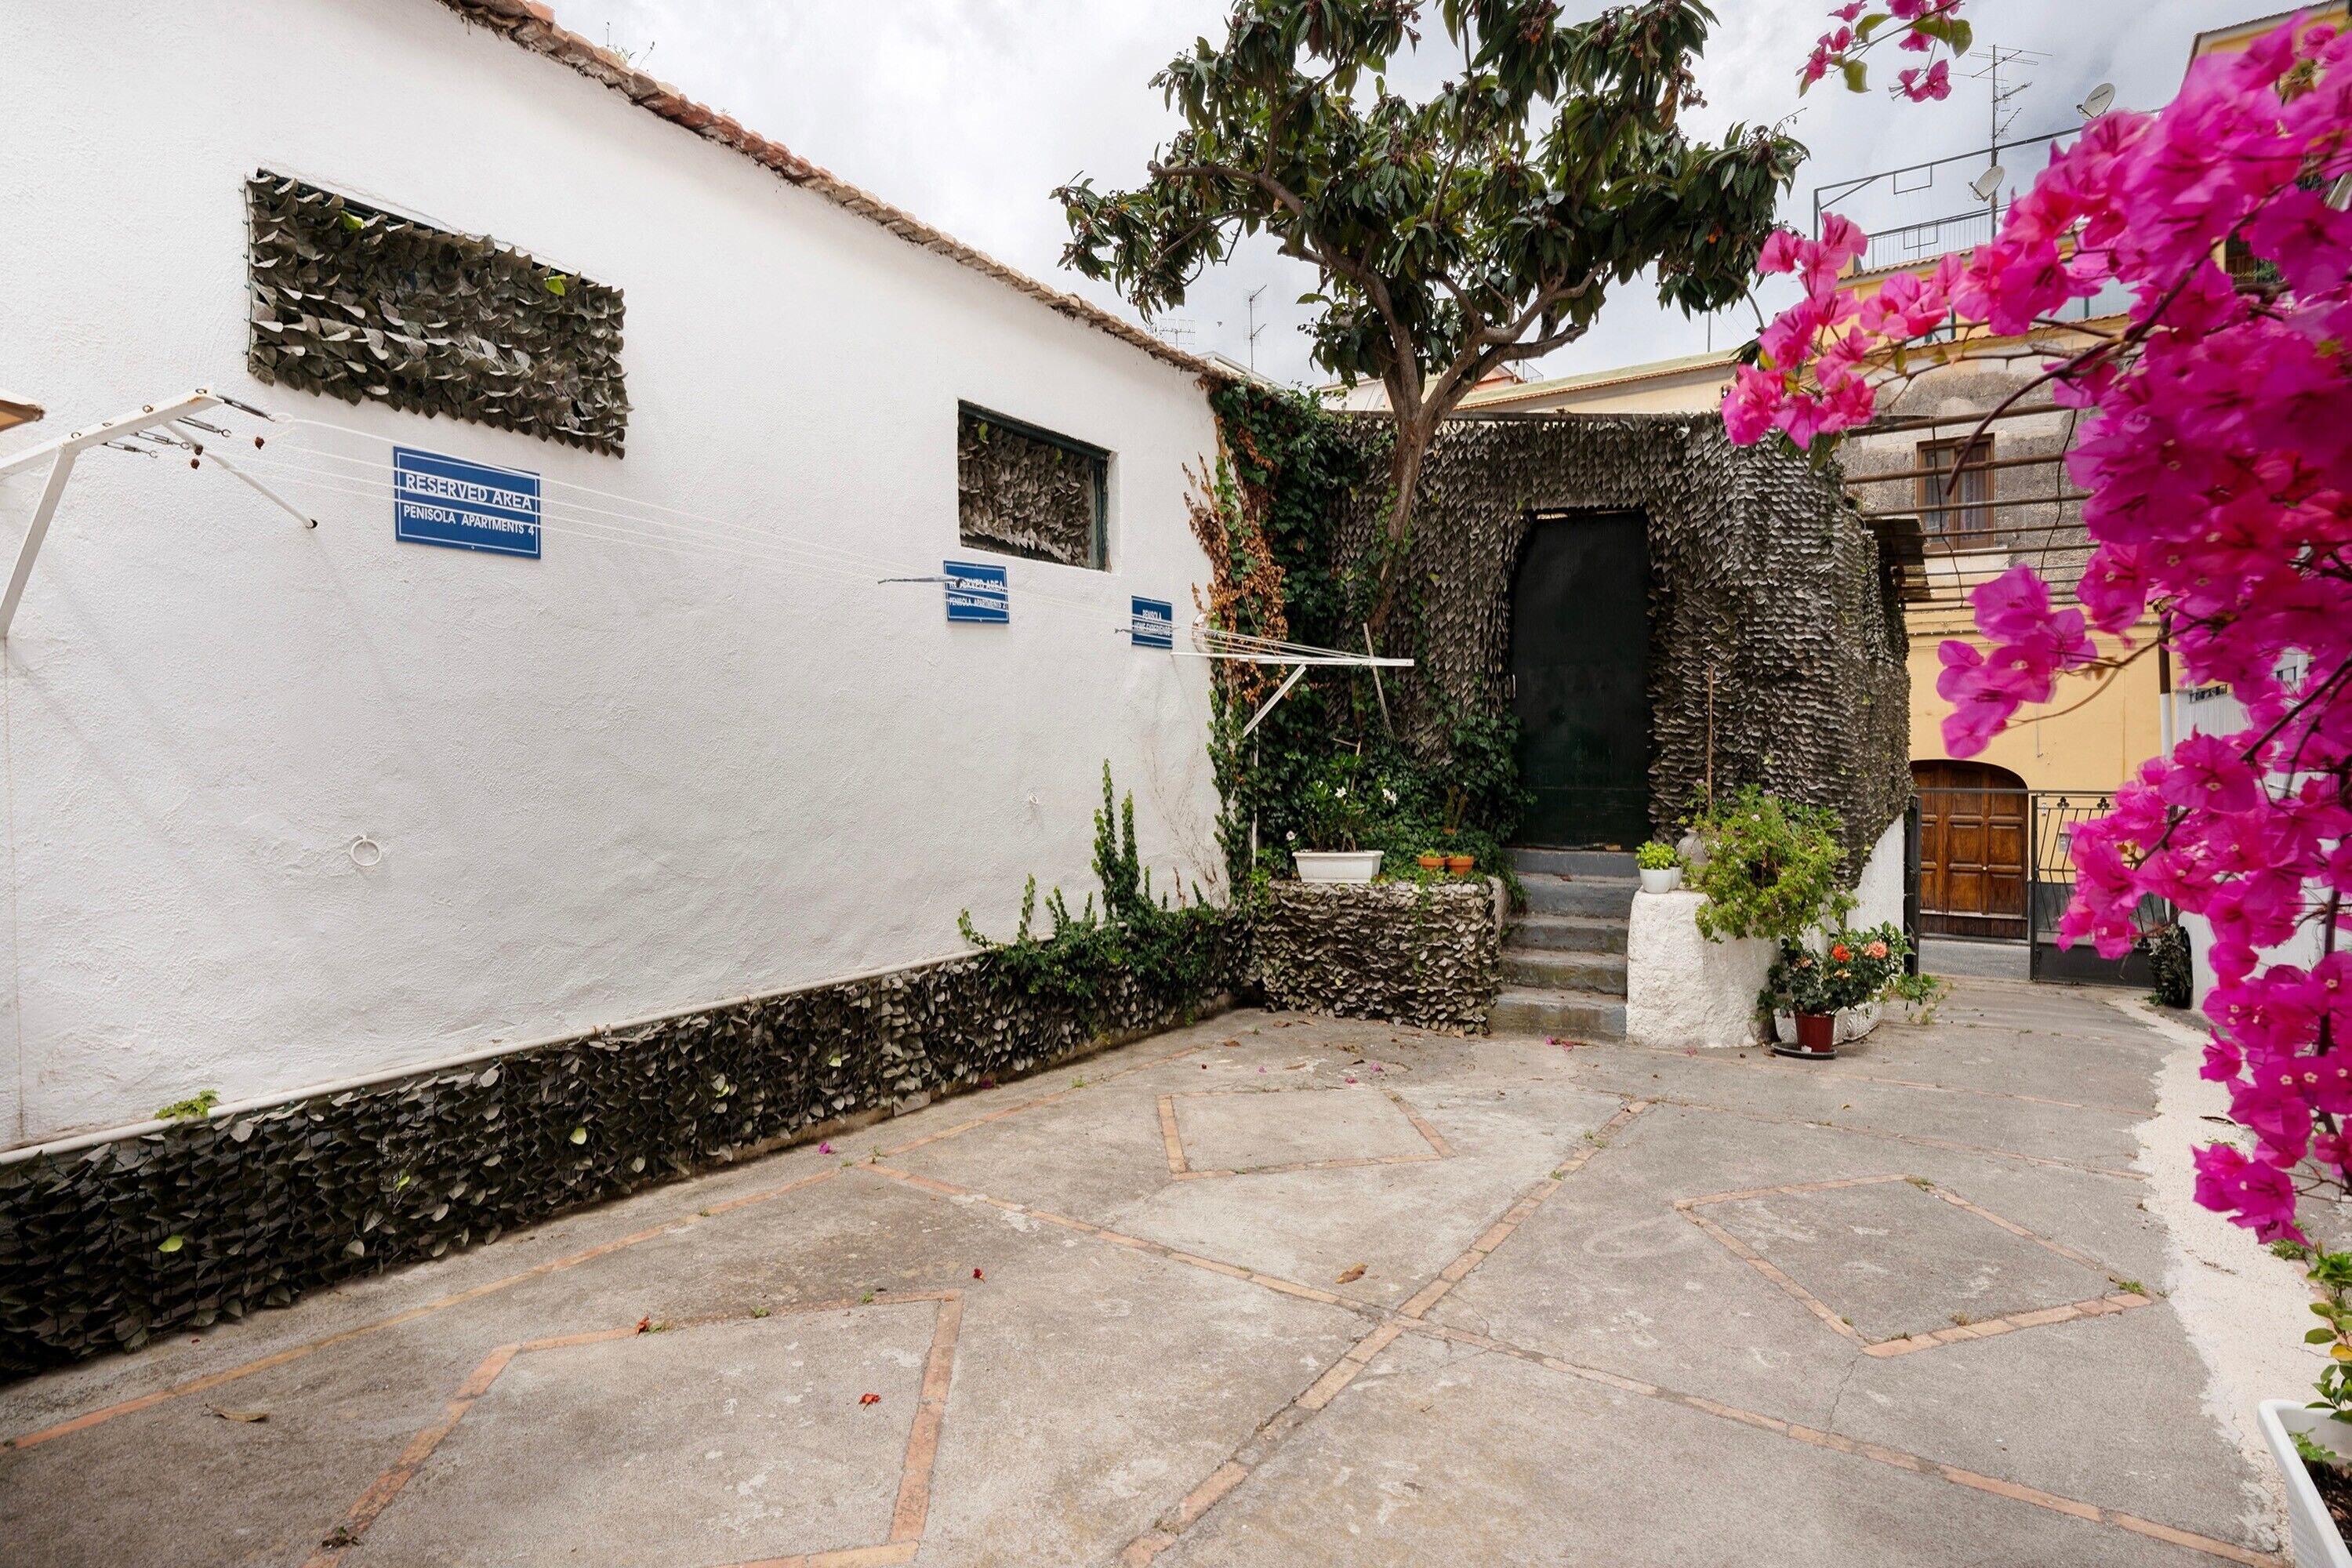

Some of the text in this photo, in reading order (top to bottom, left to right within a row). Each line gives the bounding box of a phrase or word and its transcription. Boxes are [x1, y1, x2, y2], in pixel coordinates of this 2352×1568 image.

[406, 474, 532, 510] RESERVED AREA
[404, 504, 534, 535] PENISOLA APARTMENTS 4
